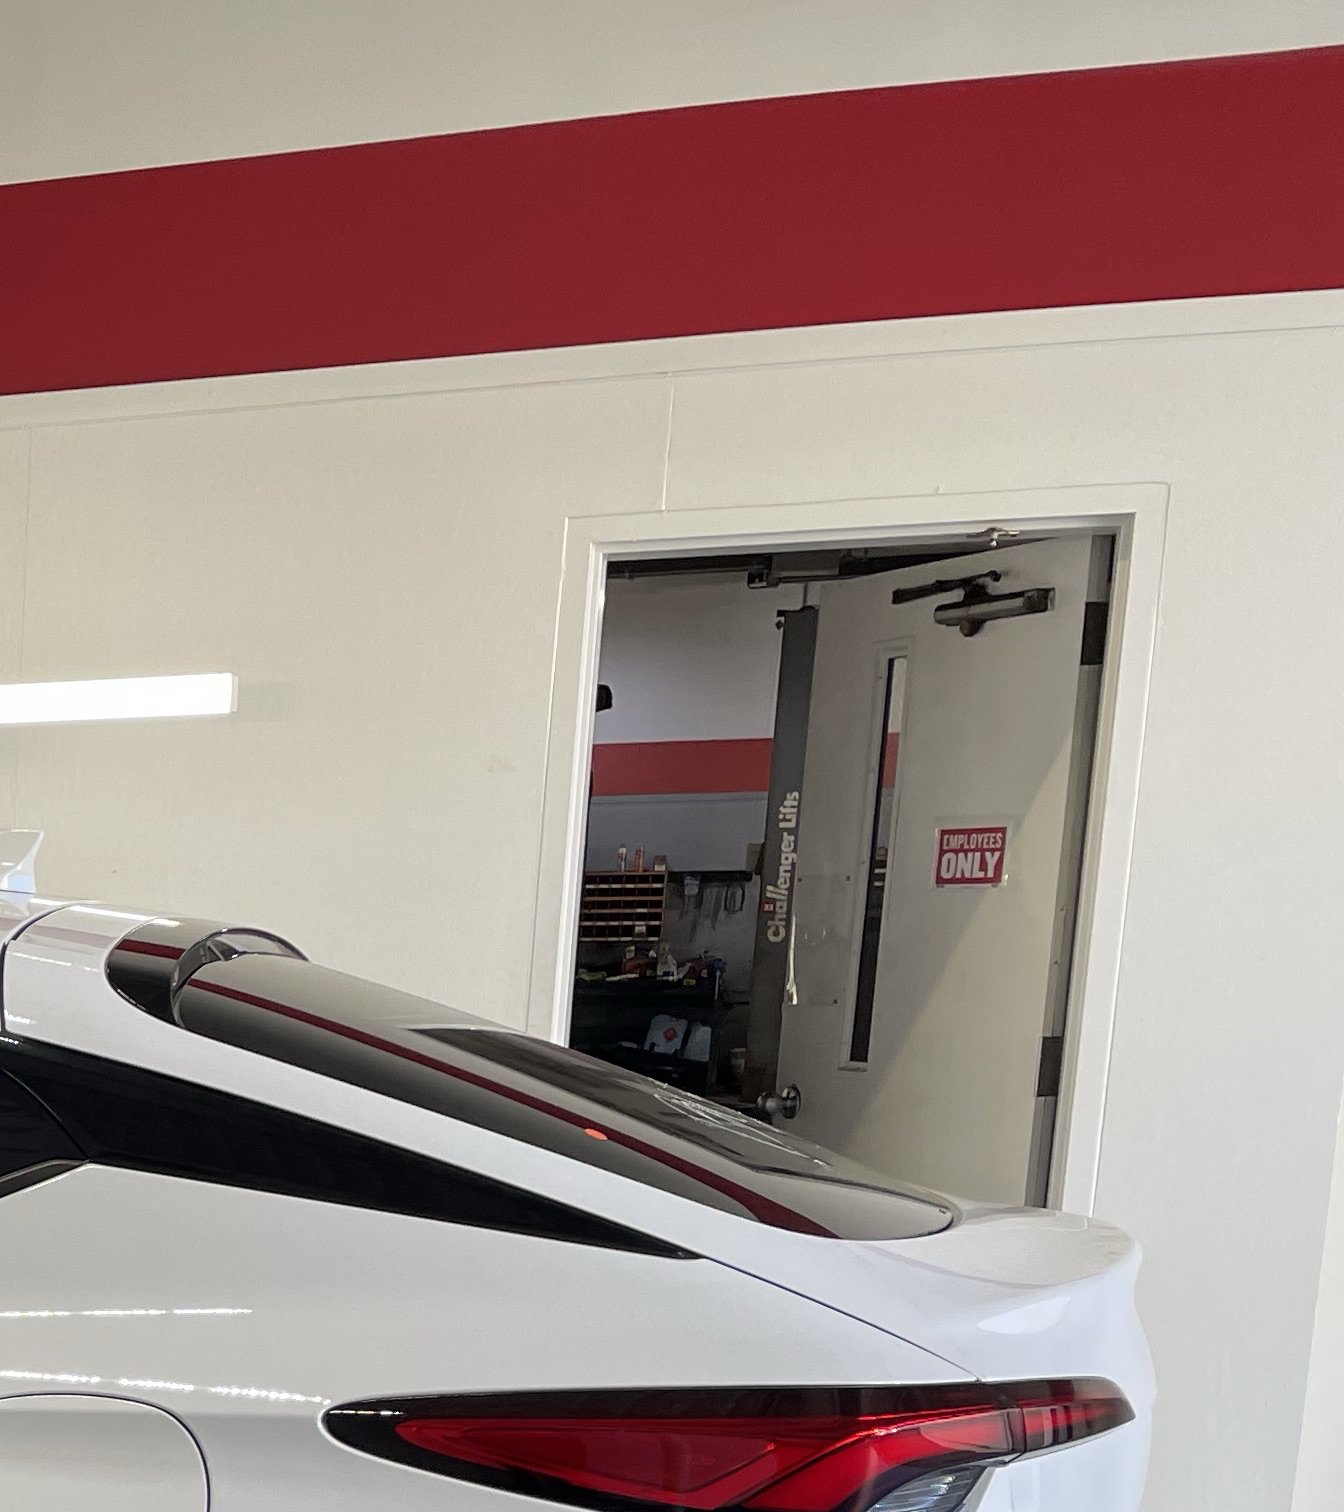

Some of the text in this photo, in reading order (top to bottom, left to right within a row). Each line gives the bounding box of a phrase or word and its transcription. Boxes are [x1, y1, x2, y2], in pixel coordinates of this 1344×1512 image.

[942, 832, 1003, 850] EMPLOYEES
[766, 791, 800, 943] Challenger Lifts
[940, 851, 1002, 879] ONLY
